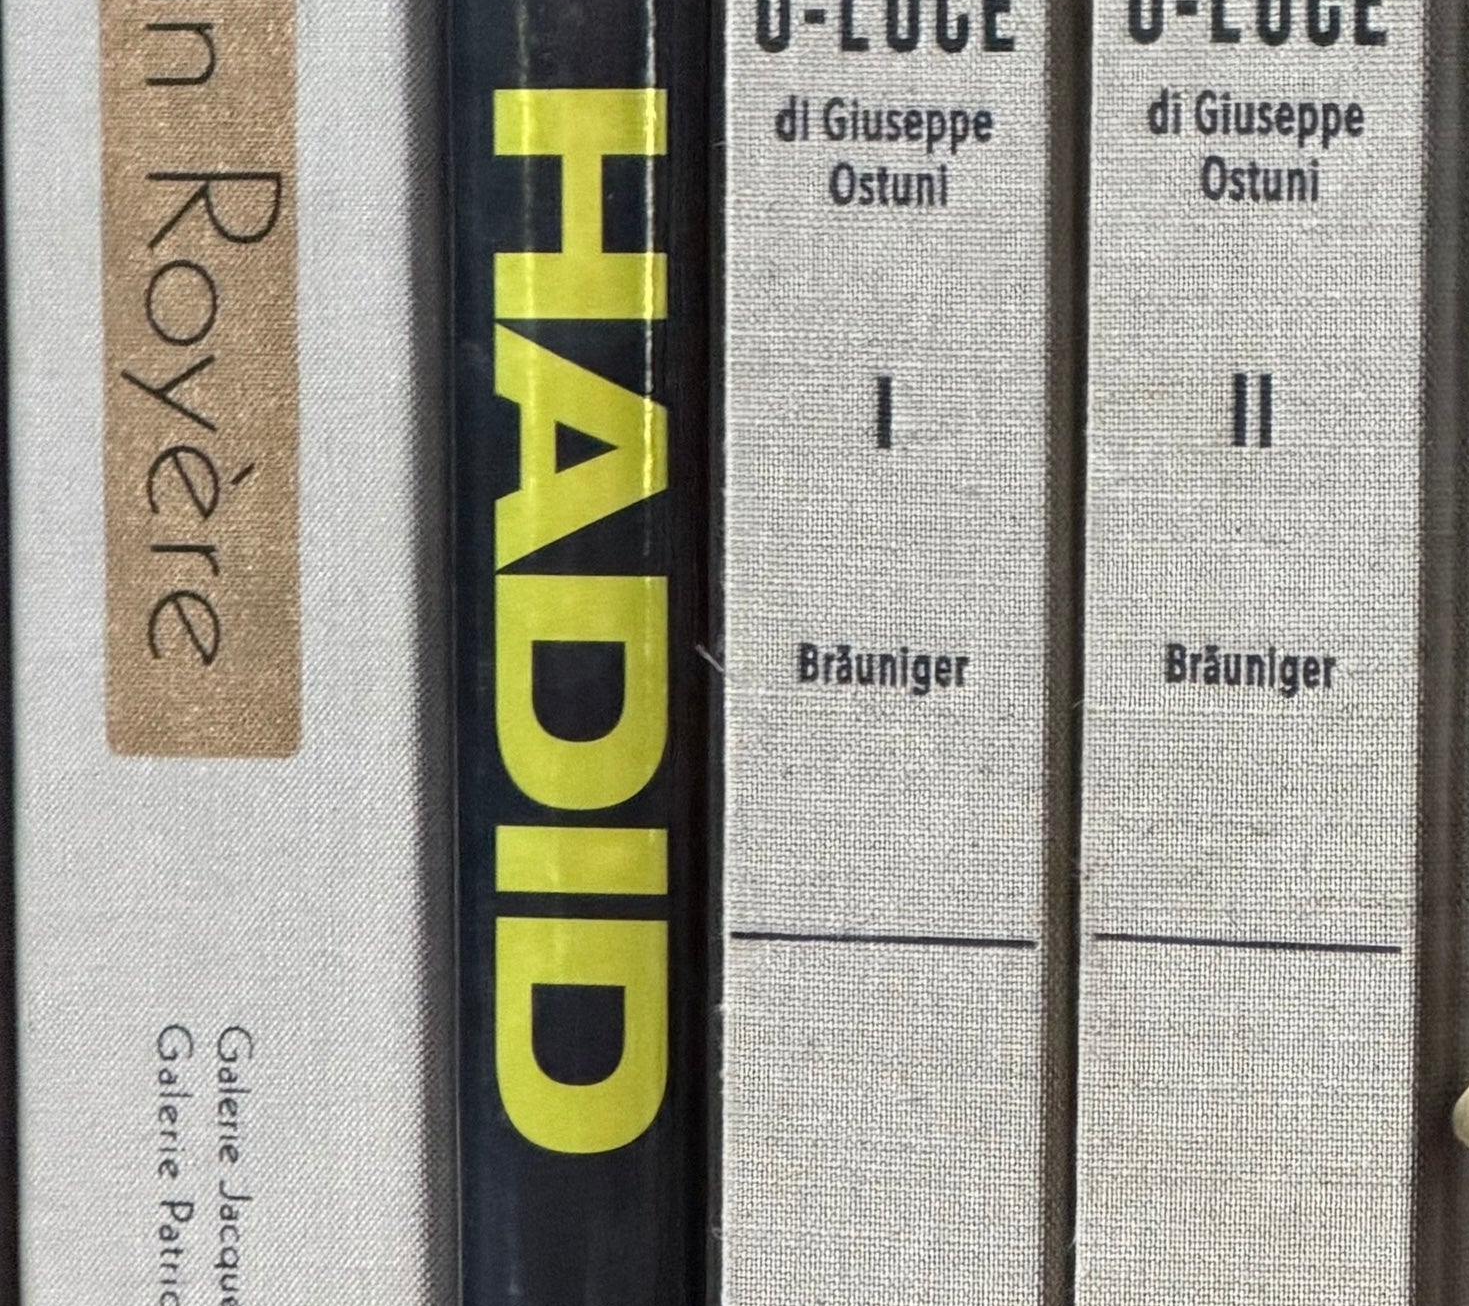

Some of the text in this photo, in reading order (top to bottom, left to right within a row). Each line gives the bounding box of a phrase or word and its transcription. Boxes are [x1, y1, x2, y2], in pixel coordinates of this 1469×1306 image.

[774, 96, 995, 154] di Giuseppe
[1147, 89, 1365, 150] di Giuseppe
[828, 161, 949, 208] Ostuni
[1200, 154, 1320, 203] Ostuni
[121, 169, 283, 666] Royère
[875, 375, 894, 450] I
[1231, 371, 1273, 449] II
[493, 88, 669, 1155] HADID
[798, 641, 970, 694] Bräuniger
[1164, 643, 1337, 698] Bräuniger
[156, 1024, 194, 1180] Galerie
[215, 1025, 253, 1165] Galerie
